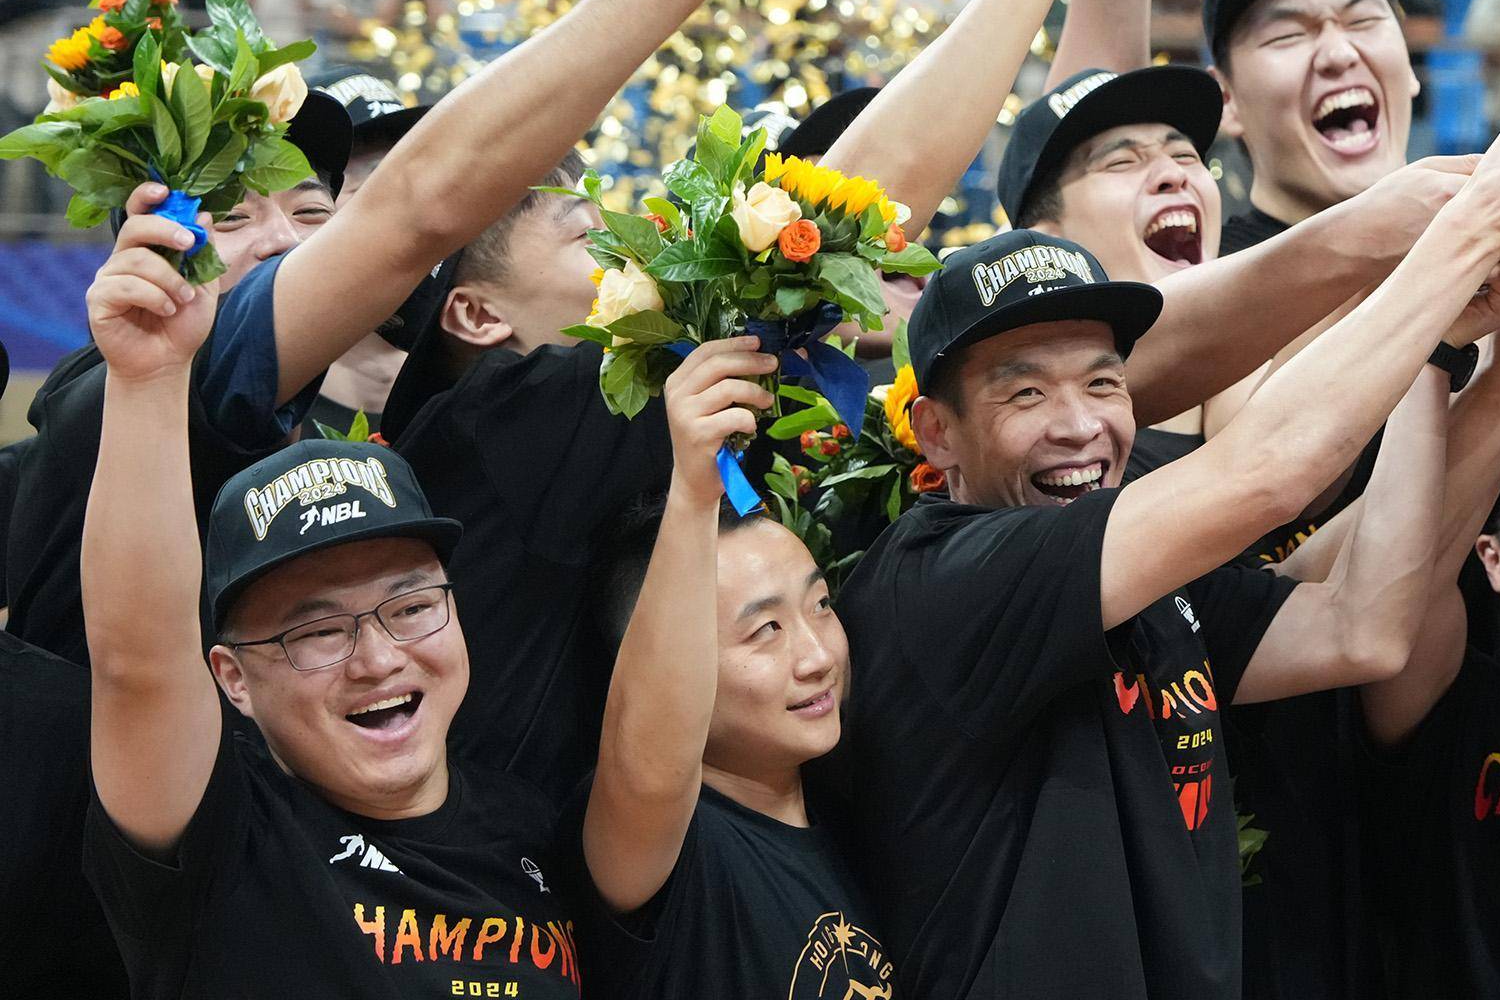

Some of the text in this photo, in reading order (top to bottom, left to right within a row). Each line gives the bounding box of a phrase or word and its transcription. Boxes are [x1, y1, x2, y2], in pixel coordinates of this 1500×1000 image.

[244, 457, 396, 541] CHAMPIONS
[299, 482, 346, 507] 2024
[321, 501, 367, 526] NBL
[1177, 728, 1213, 749] 2024
[451, 980, 519, 998] 2024
